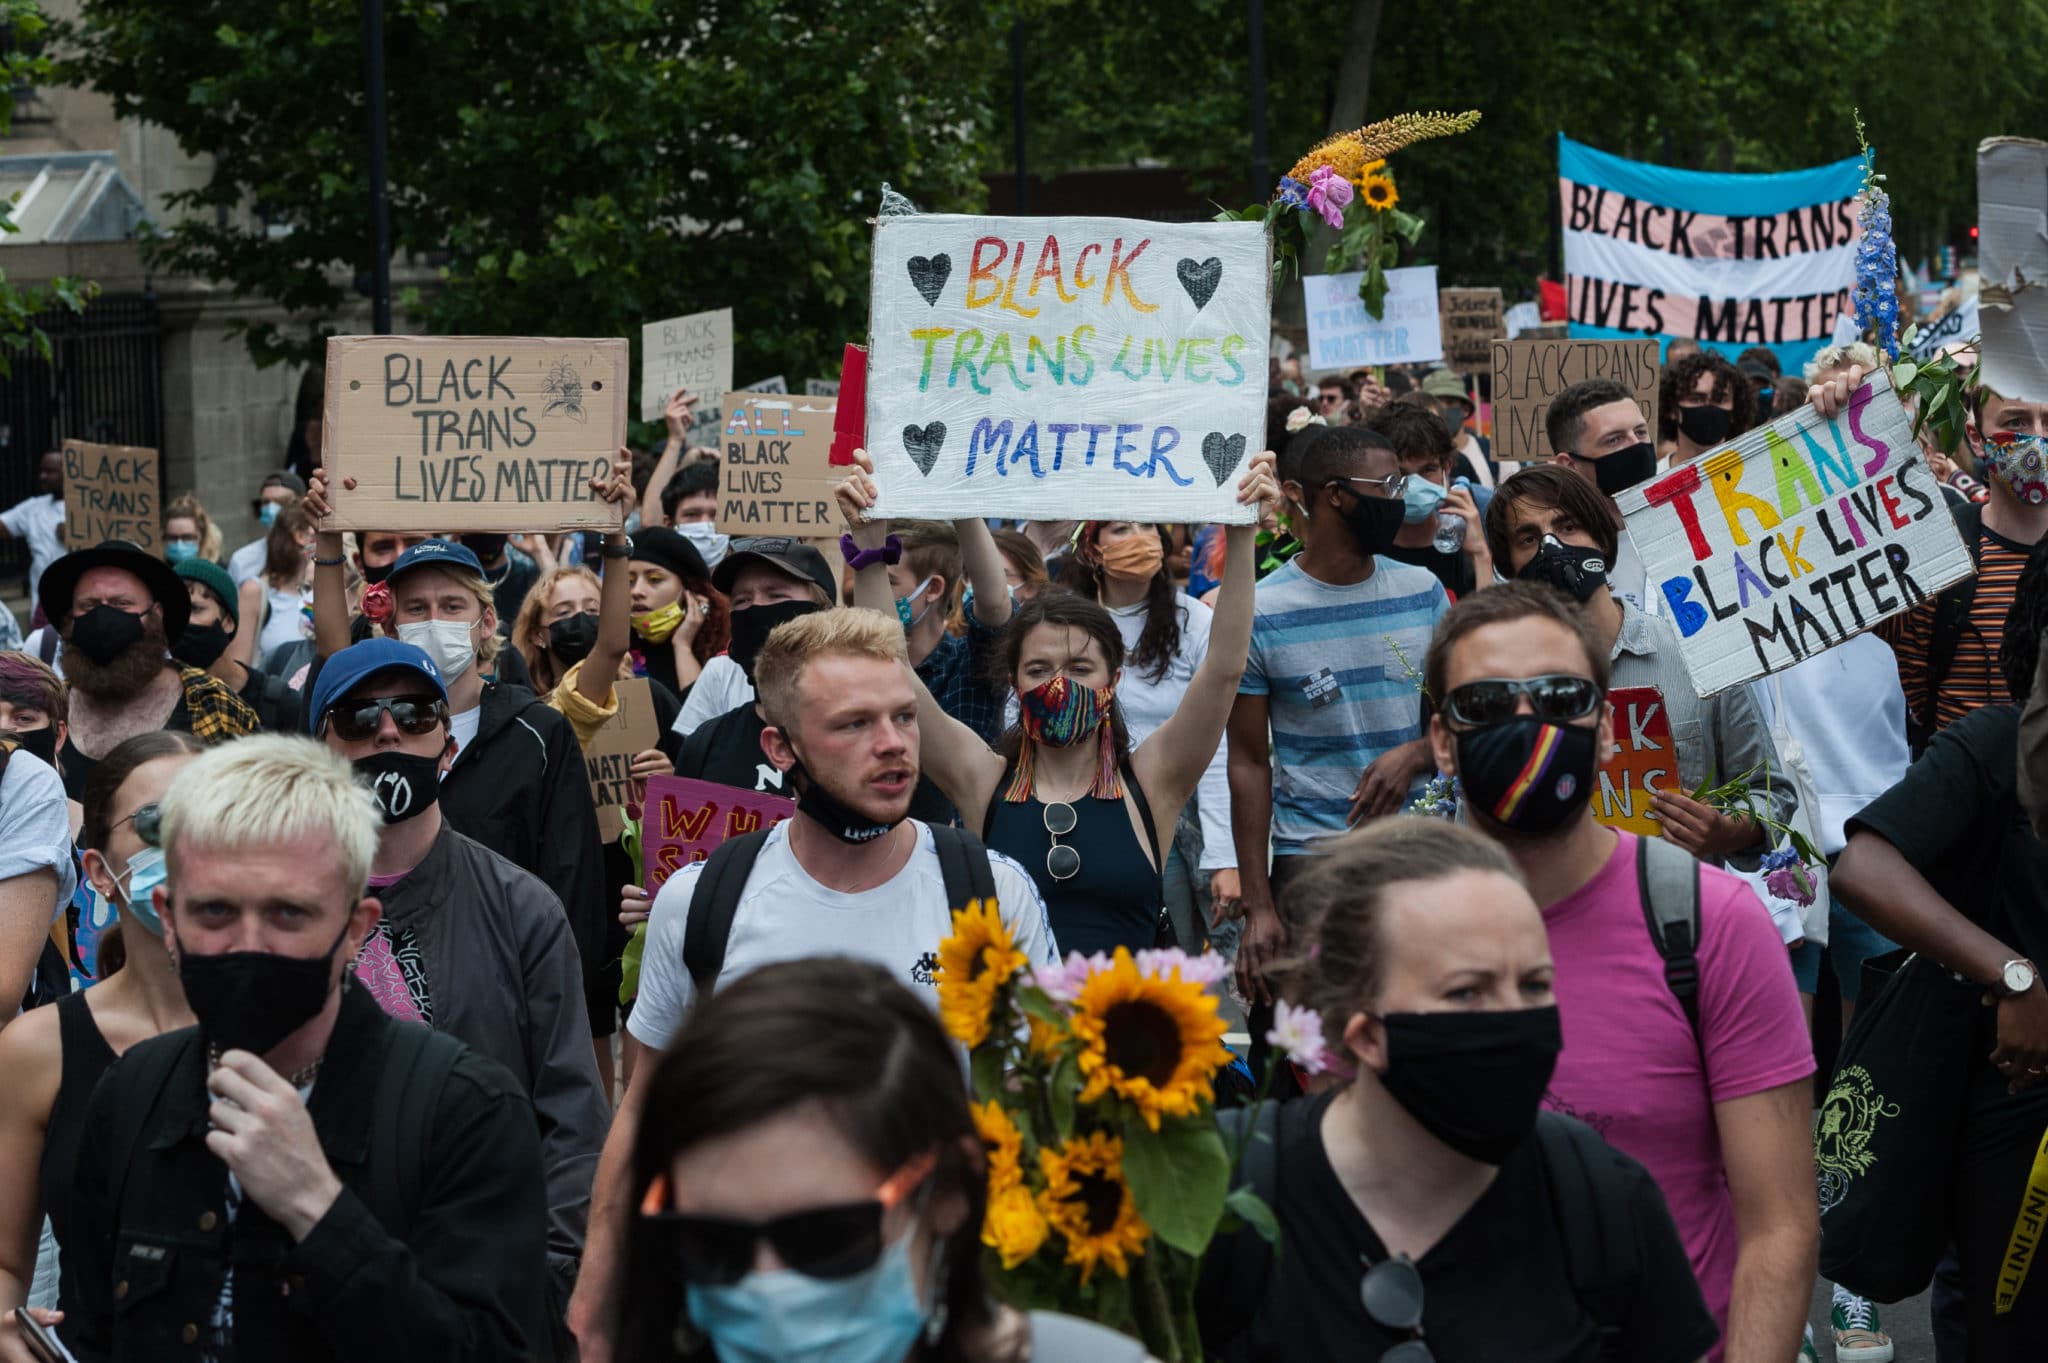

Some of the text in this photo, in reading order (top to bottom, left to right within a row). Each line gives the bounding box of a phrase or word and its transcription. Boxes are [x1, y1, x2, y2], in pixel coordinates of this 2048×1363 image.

[1569, 181, 1854, 260] BLACK TRANS
[965, 234, 1160, 319] BLACK
[663, 319, 716, 346] BLACK
[1313, 303, 1374, 330] TRAN
[660, 341, 715, 367] TRANS
[910, 324, 1246, 396] TRANS LIVES
[1320, 326, 1411, 364] MATTER
[384, 353, 516, 407] BLACK
[663, 364, 714, 388] LIVES
[1493, 343, 1573, 401] BLACK
[412, 406, 537, 457] TRANS
[726, 408, 805, 436] ALL
[1494, 403, 1553, 458] LIVE
[65, 447, 154, 486] BLACK
[727, 440, 792, 465] BLACK
[964, 416, 1195, 488] MATTER
[1642, 382, 1892, 562] TRANS
[73, 484, 151, 517] TRANS
[395, 455, 486, 502] LIVES
[727, 470, 782, 494] LIVES
[69, 509, 153, 548] LIVES
[723, 499, 831, 524] MATTER
[1660, 456, 1934, 639] BLACK LIVES
[1742, 543, 1927, 674] MATTER
[1998, 1185, 2048, 1308] INFINITE
